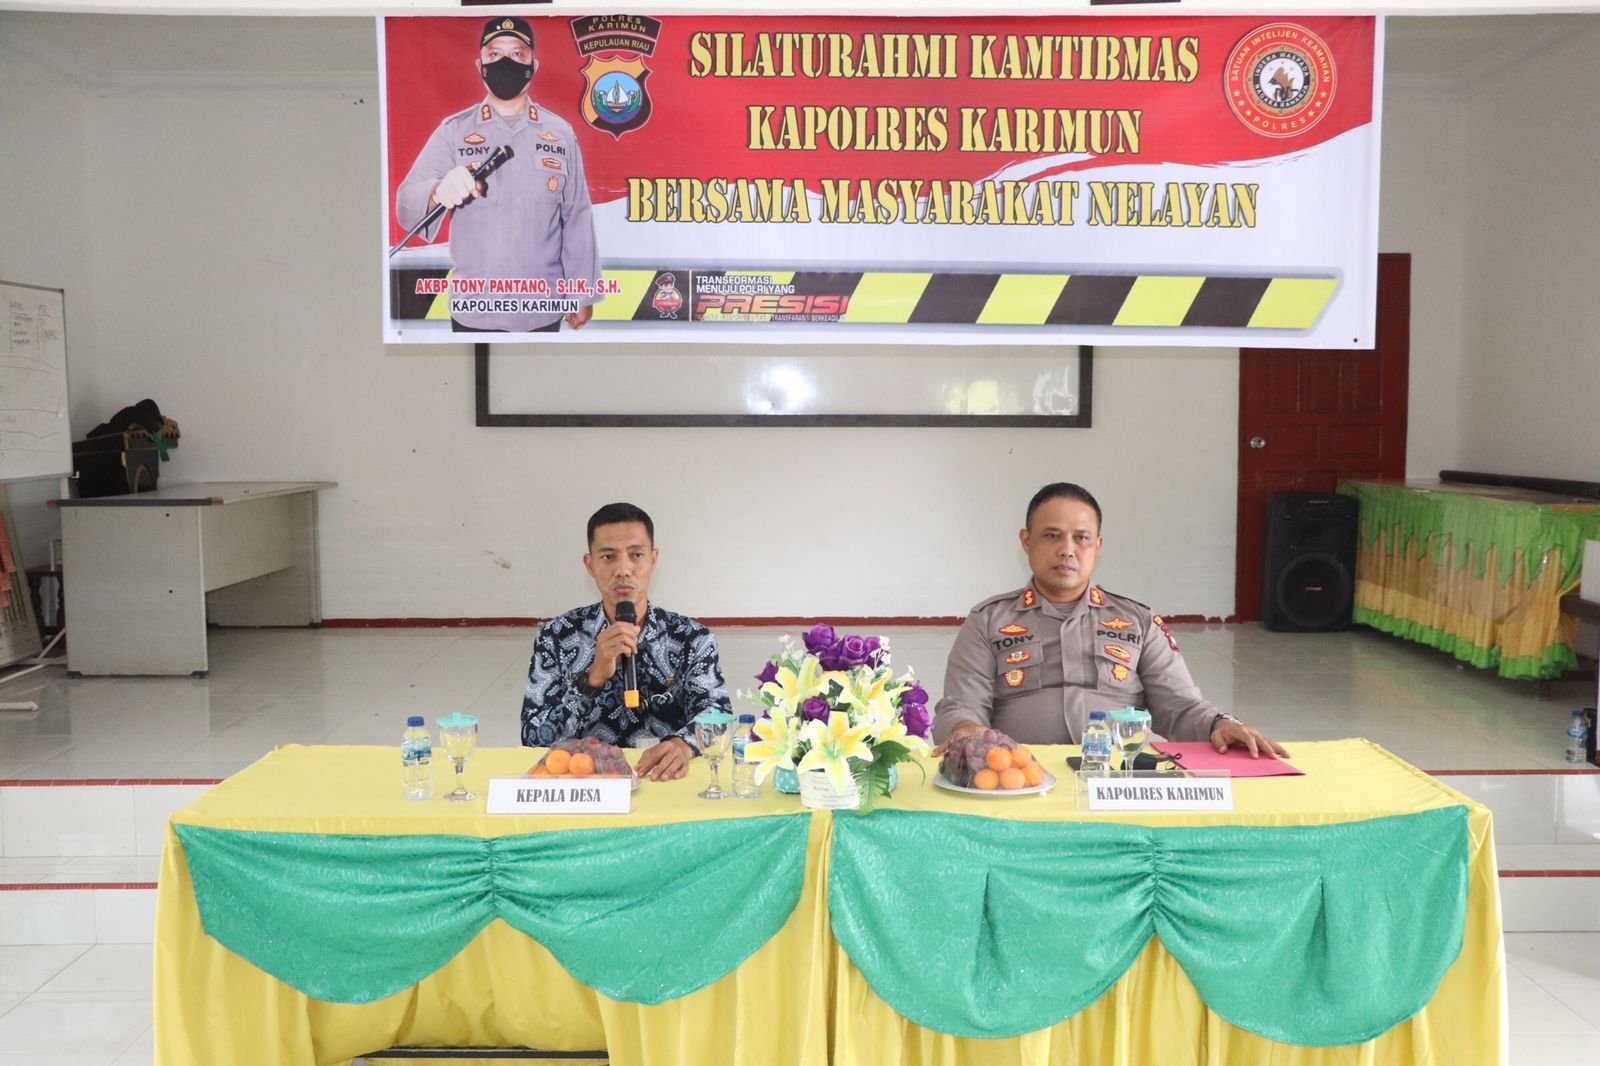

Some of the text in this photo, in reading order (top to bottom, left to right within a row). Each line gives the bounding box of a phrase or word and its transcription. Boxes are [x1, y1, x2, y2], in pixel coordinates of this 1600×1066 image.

[588, 22, 646, 32] KARIMUN
[593, 15, 642, 24] POLRES
[583, 39, 650, 51] KEPULAUAN RIAU
[689, 32, 1200, 82] SILATURAHMI KAMTIBMAS
[1232, 30, 1330, 83] SATUAN INTELIJEN KEAMANAN
[1280, 52, 1309, 78] WASPADA
[746, 105, 1142, 154] KAPOLRES KARIMUN
[1253, 116, 1306, 130] POLRES
[458, 146, 490, 156] TONY
[536, 143, 566, 155] POLRI
[627, 177, 1259, 228] BERSAMA MASYARAKAT NELAYAN
[415, 278, 449, 294] AKBP
[452, 279, 486, 293] TONY
[489, 279, 550, 296] PANTANO,
[596, 279, 621, 294] S.H.
[696, 275, 773, 284] TRANSFORMASI
[696, 284, 795, 295] MENUJU POLRI YANG
[452, 300, 578, 313] KAPOLRES KARIMUN
[696, 295, 850, 314] PRESISI
[993, 634, 1035, 651] TONY
[1096, 629, 1140, 645] POLRI
[516, 788, 601, 803] KEPALA DESA
[1096, 786, 1224, 801] KAPOLRES KARIMUN
